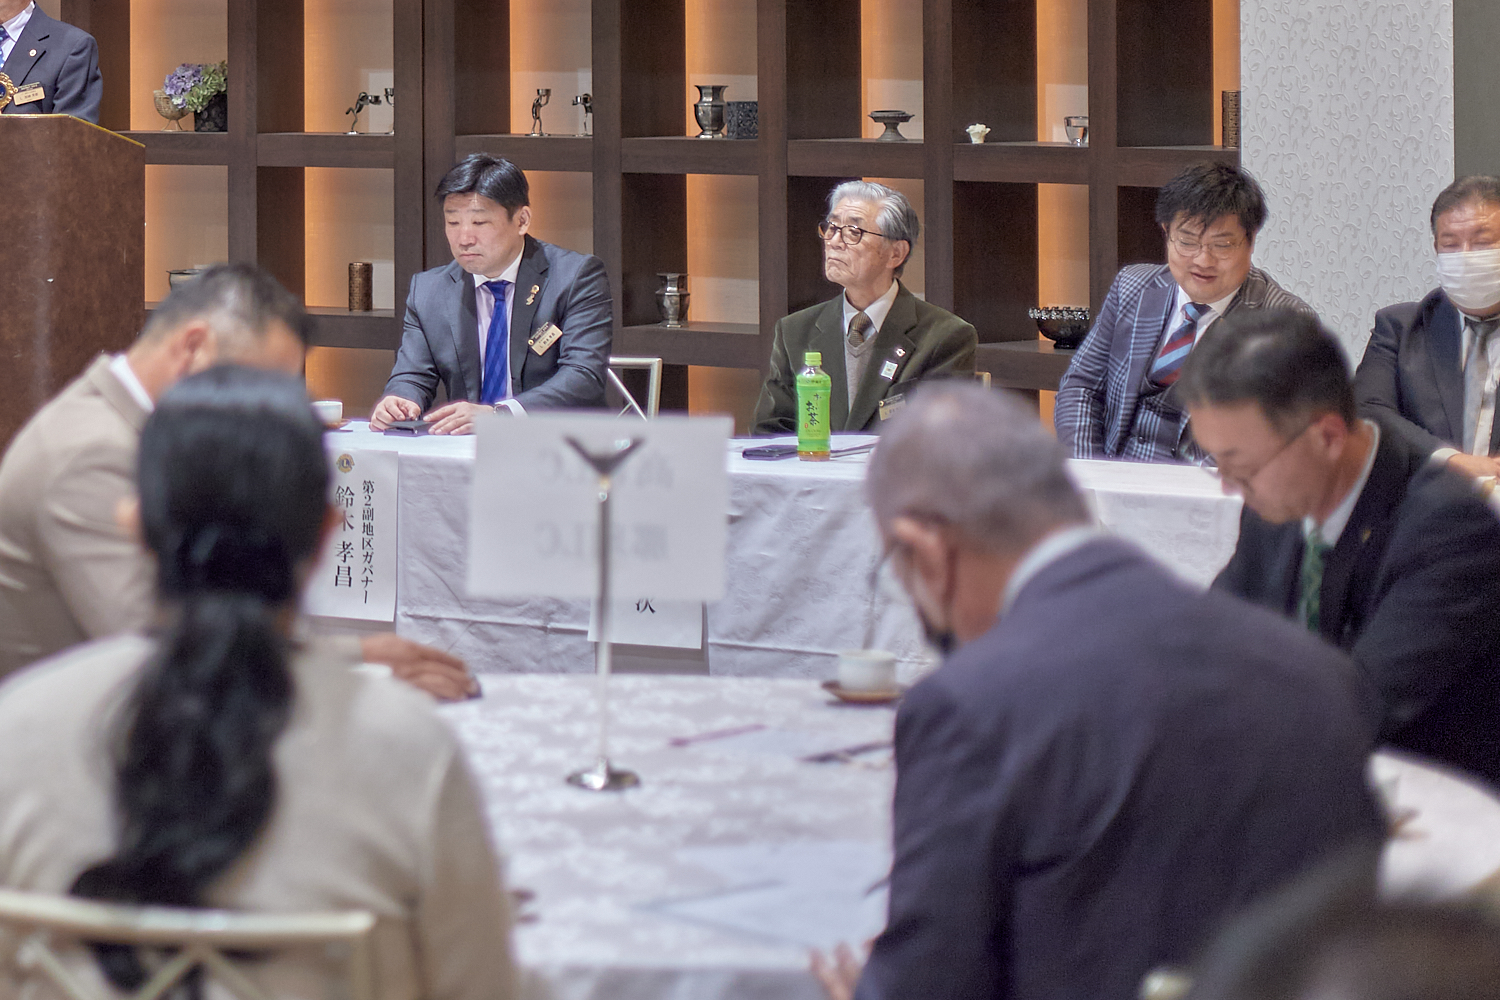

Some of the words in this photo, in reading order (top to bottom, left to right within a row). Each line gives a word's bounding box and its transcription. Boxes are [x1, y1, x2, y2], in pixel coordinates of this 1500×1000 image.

[361, 479, 375, 604] 第2副地区ガバナー
